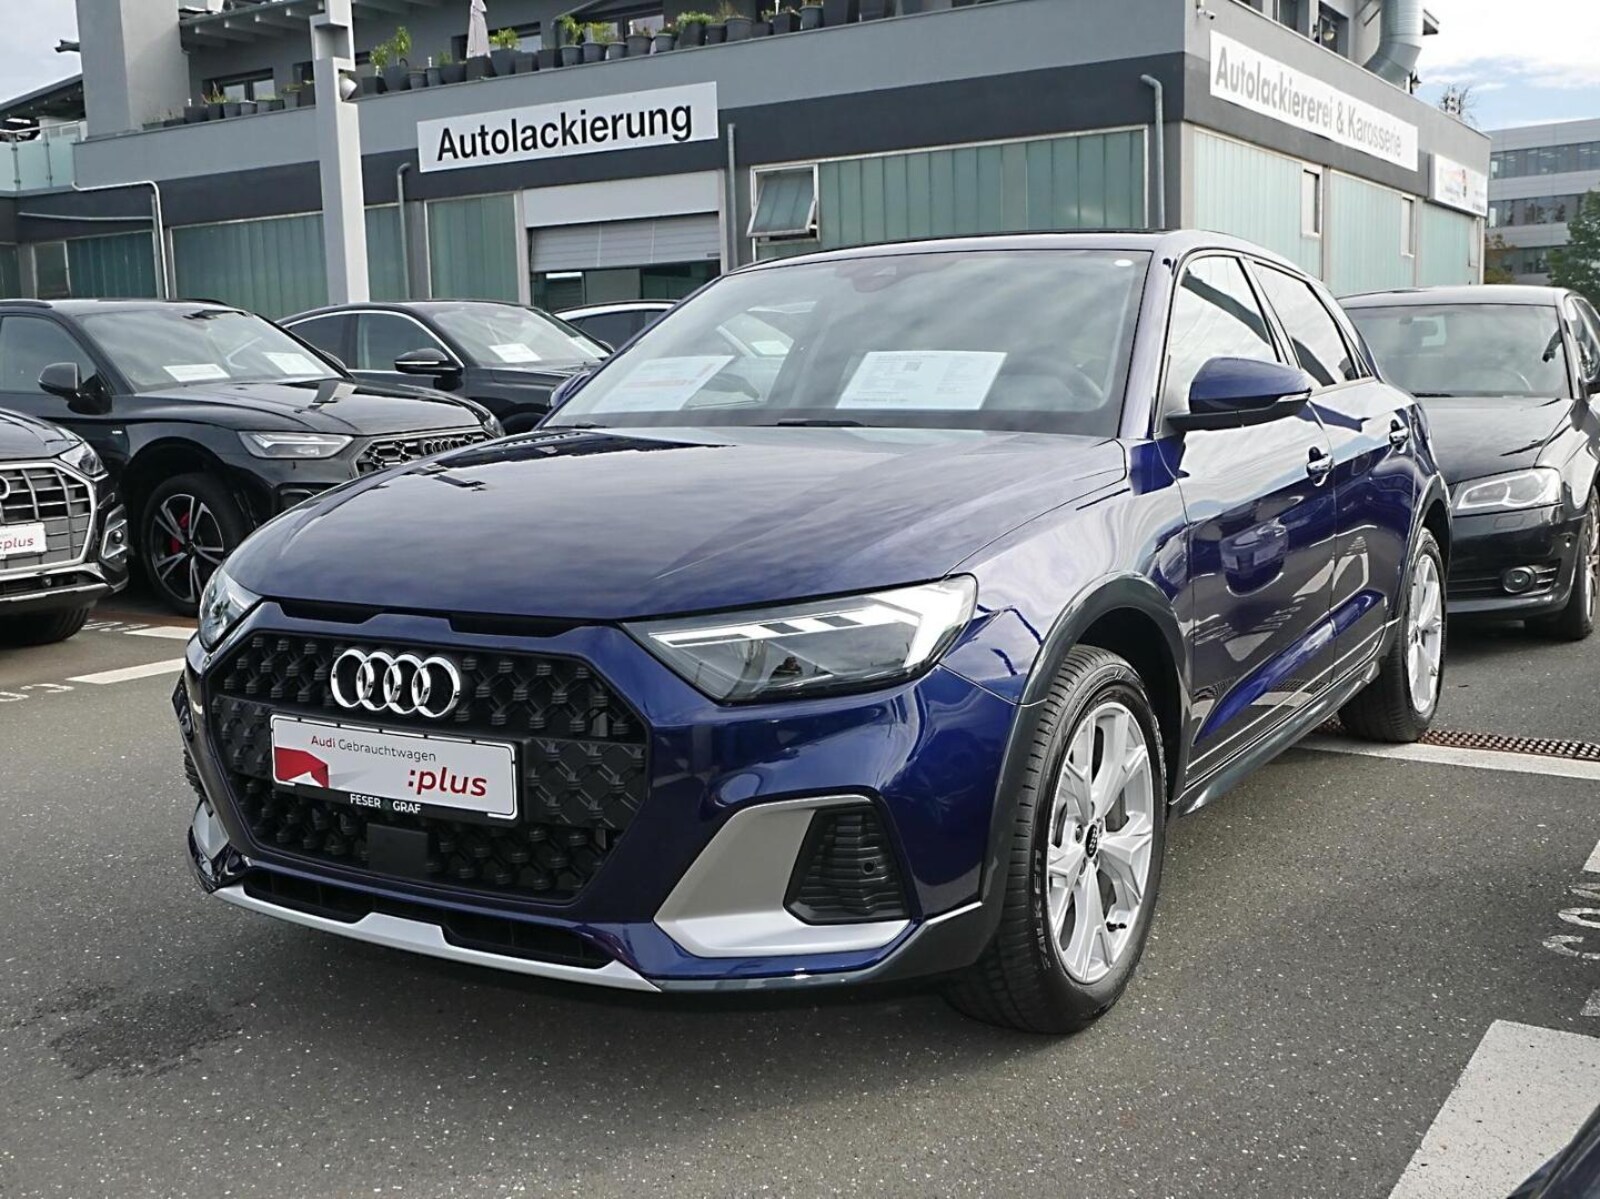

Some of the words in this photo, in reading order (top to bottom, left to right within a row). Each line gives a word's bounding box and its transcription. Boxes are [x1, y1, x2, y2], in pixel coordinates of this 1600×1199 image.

[1215, 46, 1333, 130] Autolackiererei
[1336, 101, 1345, 136] &
[1348, 104, 1402, 157] Karosserie
[436, 104, 692, 162] Autolackierung
[311, 735, 336, 749] Audi
[338, 736, 437, 763] Gebrauchtwagen
[408, 766, 488, 797] :plus
[350, 793, 381, 809] FESER
[392, 802, 421, 814] GRAF
